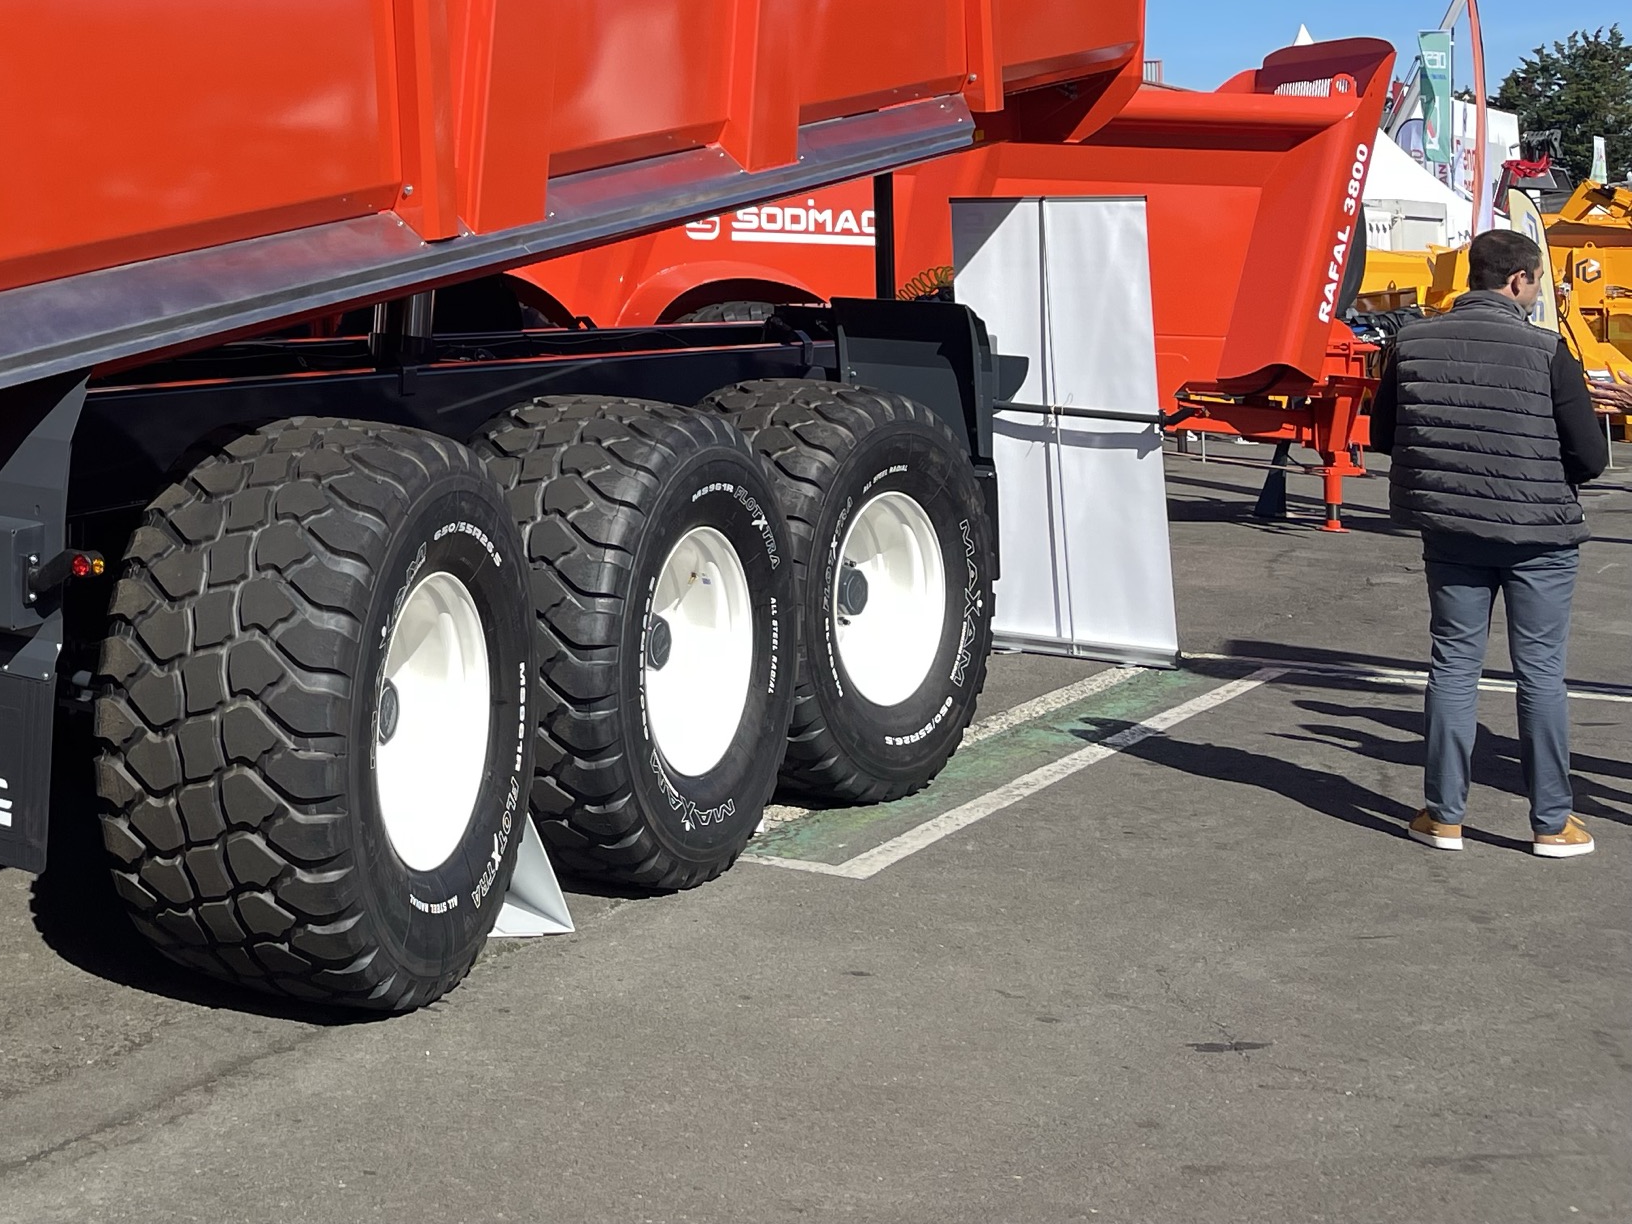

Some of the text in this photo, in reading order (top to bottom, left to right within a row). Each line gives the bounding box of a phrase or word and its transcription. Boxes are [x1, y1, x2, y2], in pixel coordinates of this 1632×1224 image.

[1317, 142, 1369, 324] RAFAL 3800
[433, 520, 503, 568] 650/55R26.5
[733, 484, 782, 571] FLOTXTRA
[767, 596, 780, 695] ALL STEEL RADIAL
[952, 518, 984, 688] MAXAM
[470, 775, 520, 909] FLOTXTRA
